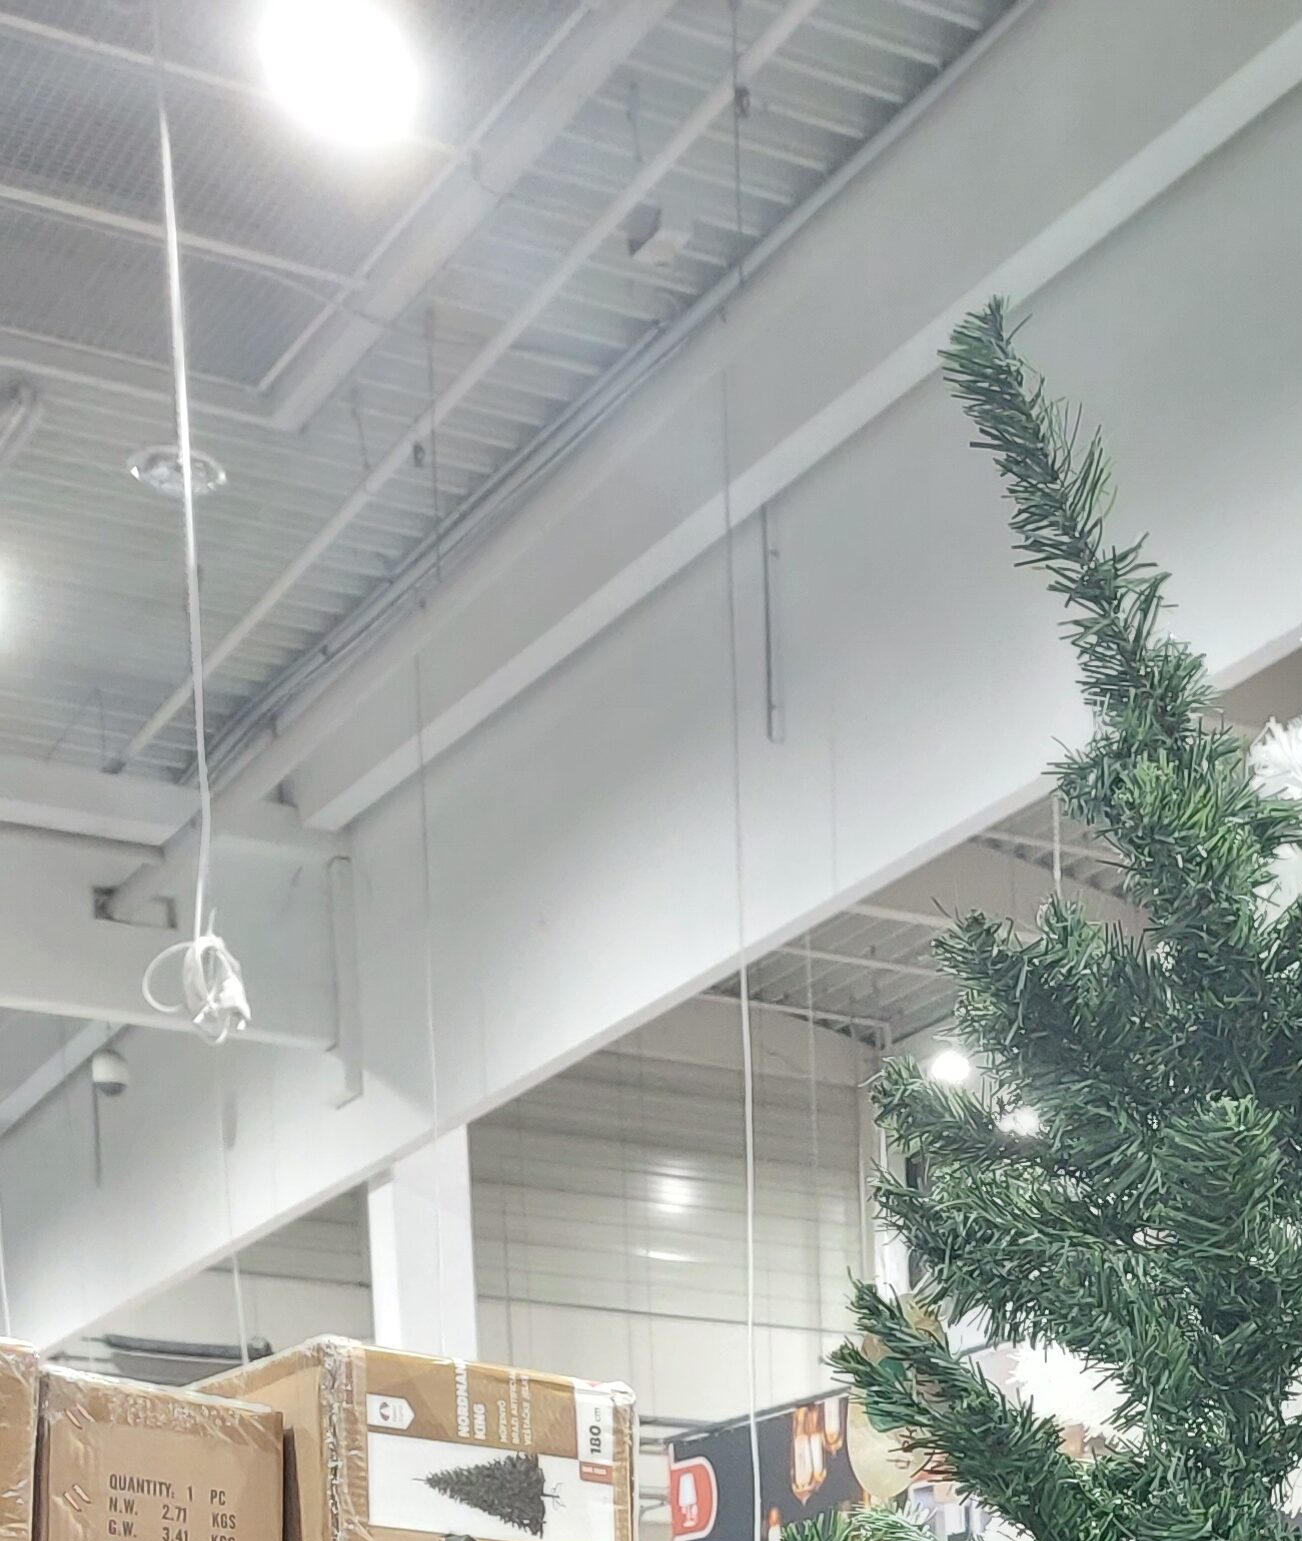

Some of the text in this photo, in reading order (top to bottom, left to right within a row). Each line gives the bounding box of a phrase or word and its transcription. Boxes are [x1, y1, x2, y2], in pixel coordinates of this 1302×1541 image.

[473, 1403, 486, 1441] KING
[590, 1407, 602, 1455] 180 cm
[109, 1473, 226, 1506] QUANTITY: 1 PC
[108, 1519, 137, 1538] G.W.
[109, 1496, 236, 1530] N.W. 2.71 KGS
